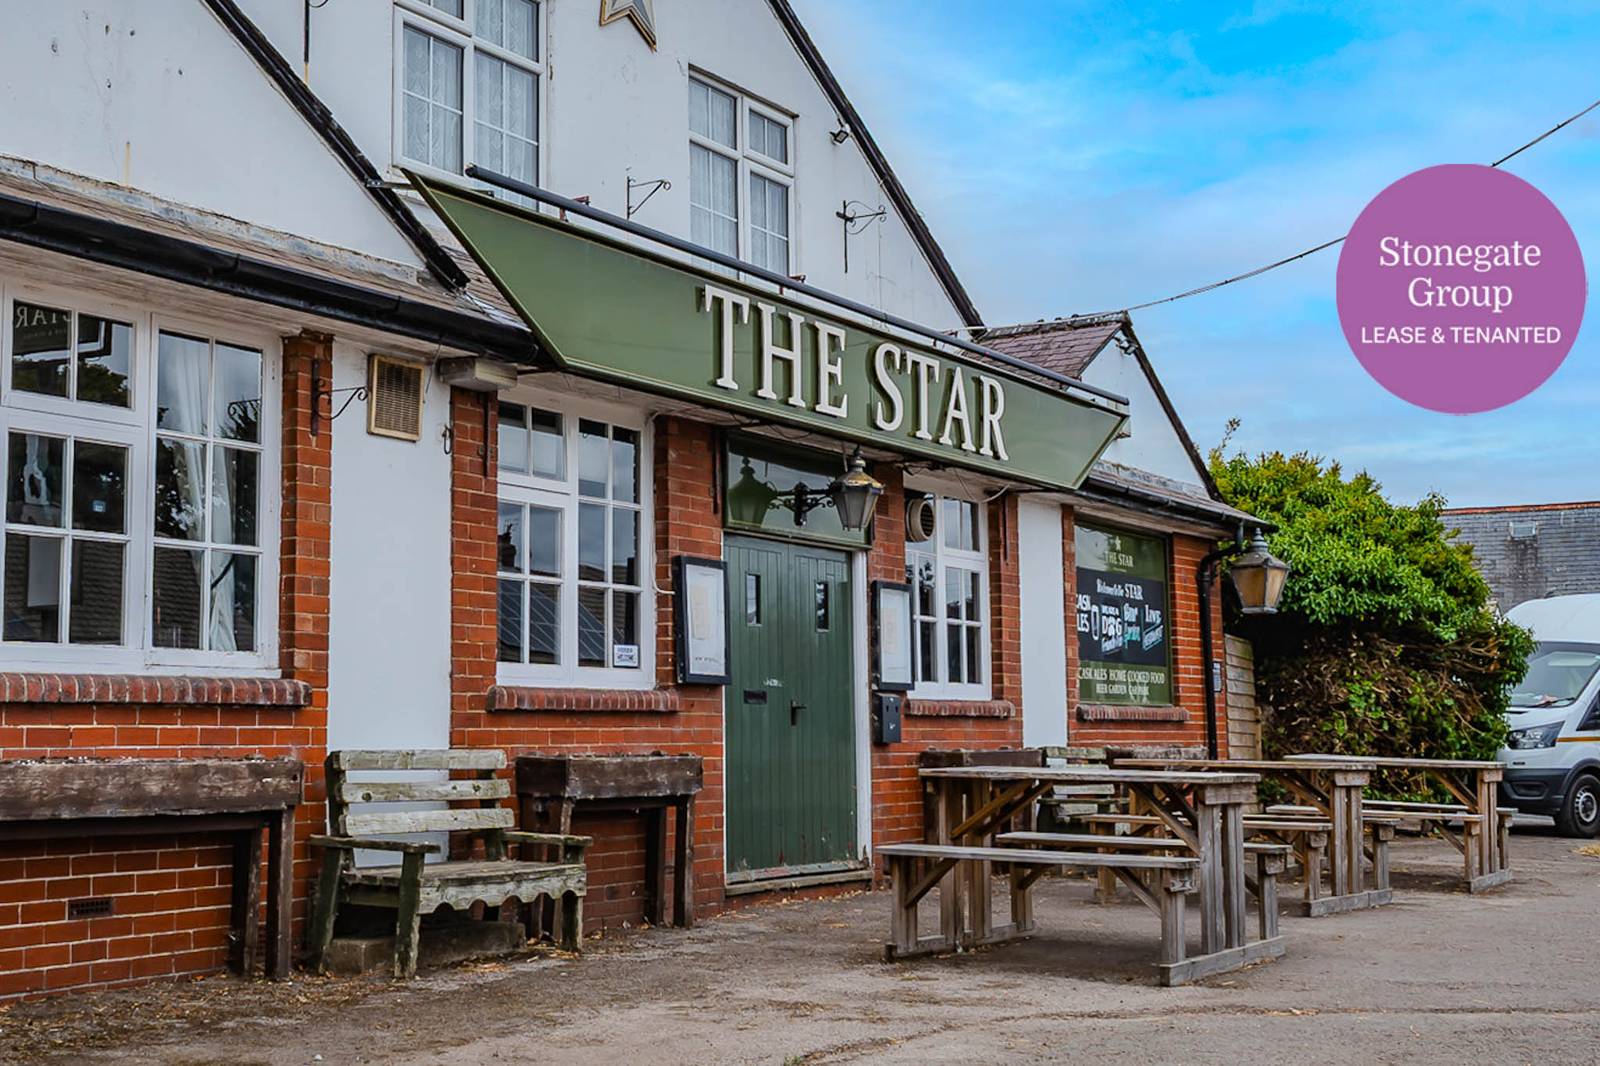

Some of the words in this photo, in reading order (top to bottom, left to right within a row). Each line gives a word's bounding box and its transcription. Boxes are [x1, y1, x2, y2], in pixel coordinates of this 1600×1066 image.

[704, 284, 848, 418] THE
[874, 342, 1009, 461] STAR
[1104, 550, 1118, 564] THE
[1118, 552, 1134, 568] STAR
[1124, 583, 1144, 600] STAR
[1076, 593, 1091, 611] ASK
[1077, 612, 1090, 633] LES
[1109, 669, 1127, 682] HOME
[1150, 672, 1165, 684] FOOD
